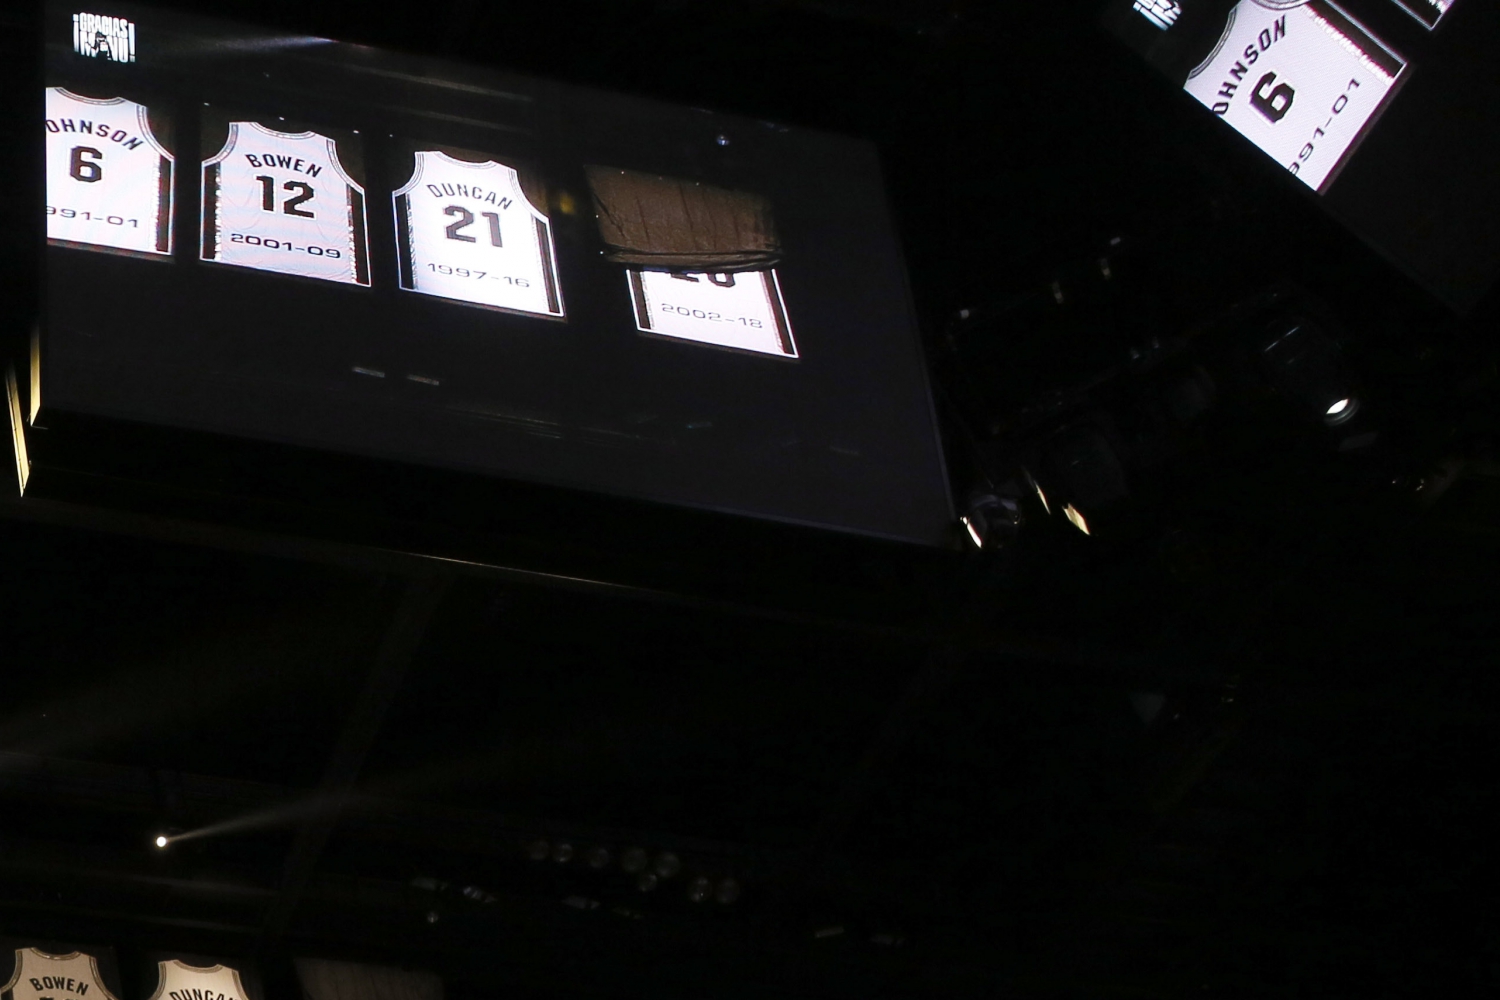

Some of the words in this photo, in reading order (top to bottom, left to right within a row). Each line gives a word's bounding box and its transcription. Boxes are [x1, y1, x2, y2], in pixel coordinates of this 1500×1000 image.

[1249, 71, 1296, 124] 6
[70, 145, 102, 183] 6
[245, 153, 322, 179] BOWEN
[255, 174, 315, 219] 12
[426, 183, 513, 211] DUNCAN
[443, 205, 503, 248] 21
[231, 233, 341, 260] 2001-09
[427, 262, 529, 288] 1997-16
[661, 303, 763, 329] 2002-18
[29, 975, 89, 996] BOWEN
